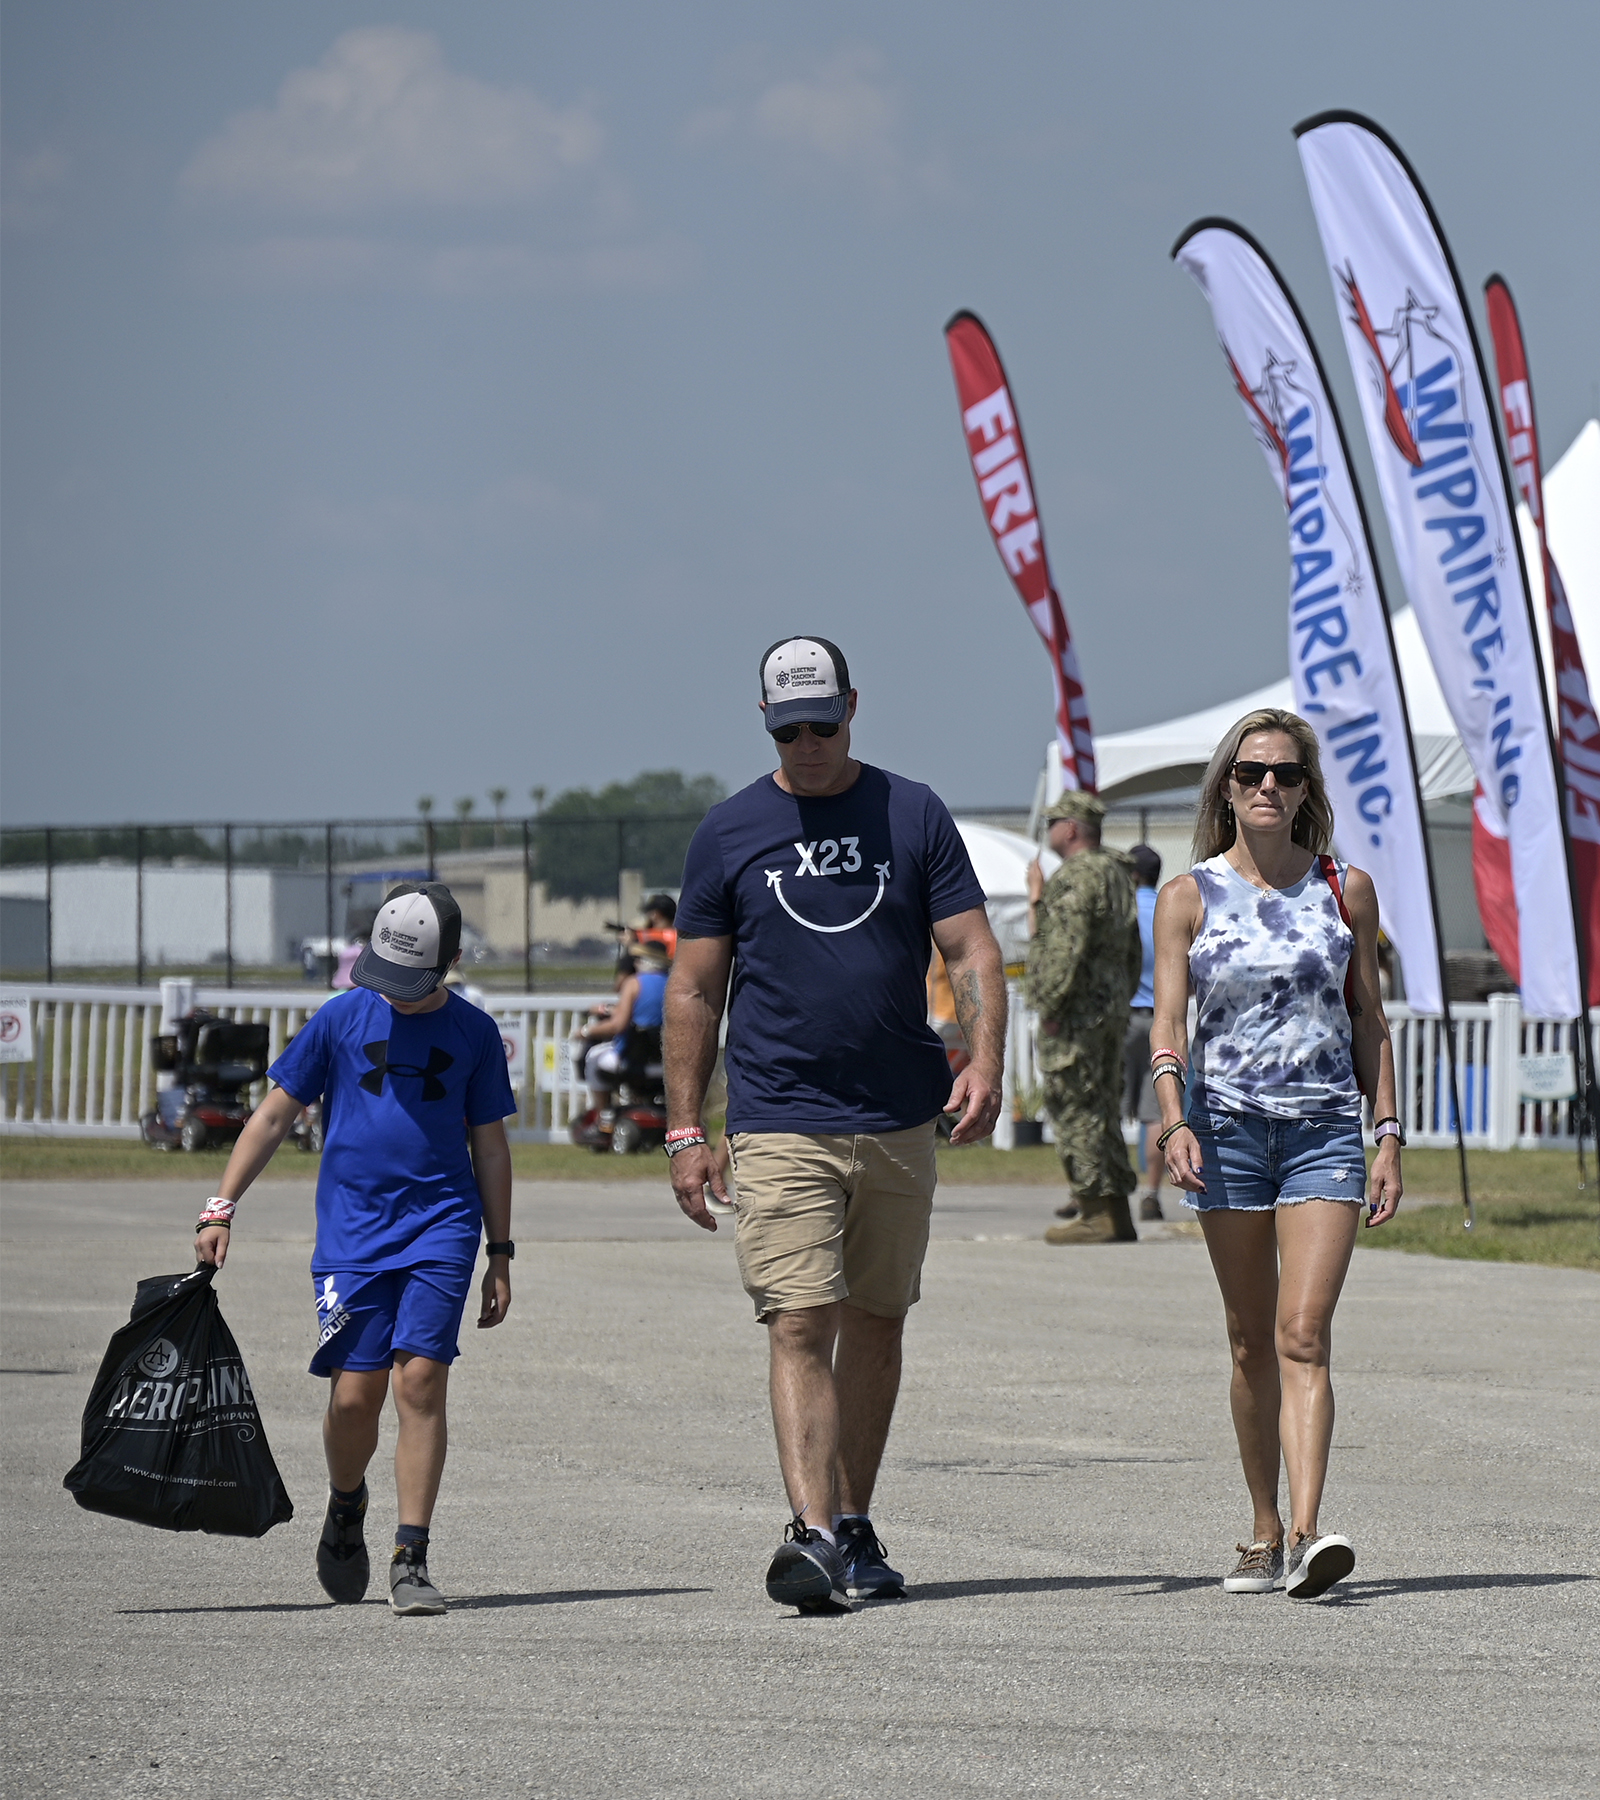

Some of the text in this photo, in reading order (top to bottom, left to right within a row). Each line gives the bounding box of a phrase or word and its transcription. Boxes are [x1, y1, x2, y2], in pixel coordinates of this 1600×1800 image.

[963, 384, 1040, 577] FIRE
[790, 673, 816, 681] MACHINE
[1327, 711, 1394, 848] INC.
[793, 836, 862, 877] X23
[389, 943, 424, 957] CORPORATION
[391, 936, 415, 948] MACHINE
[317, 1312, 351, 1348] MOUR
[320, 1303, 345, 1331] DER
